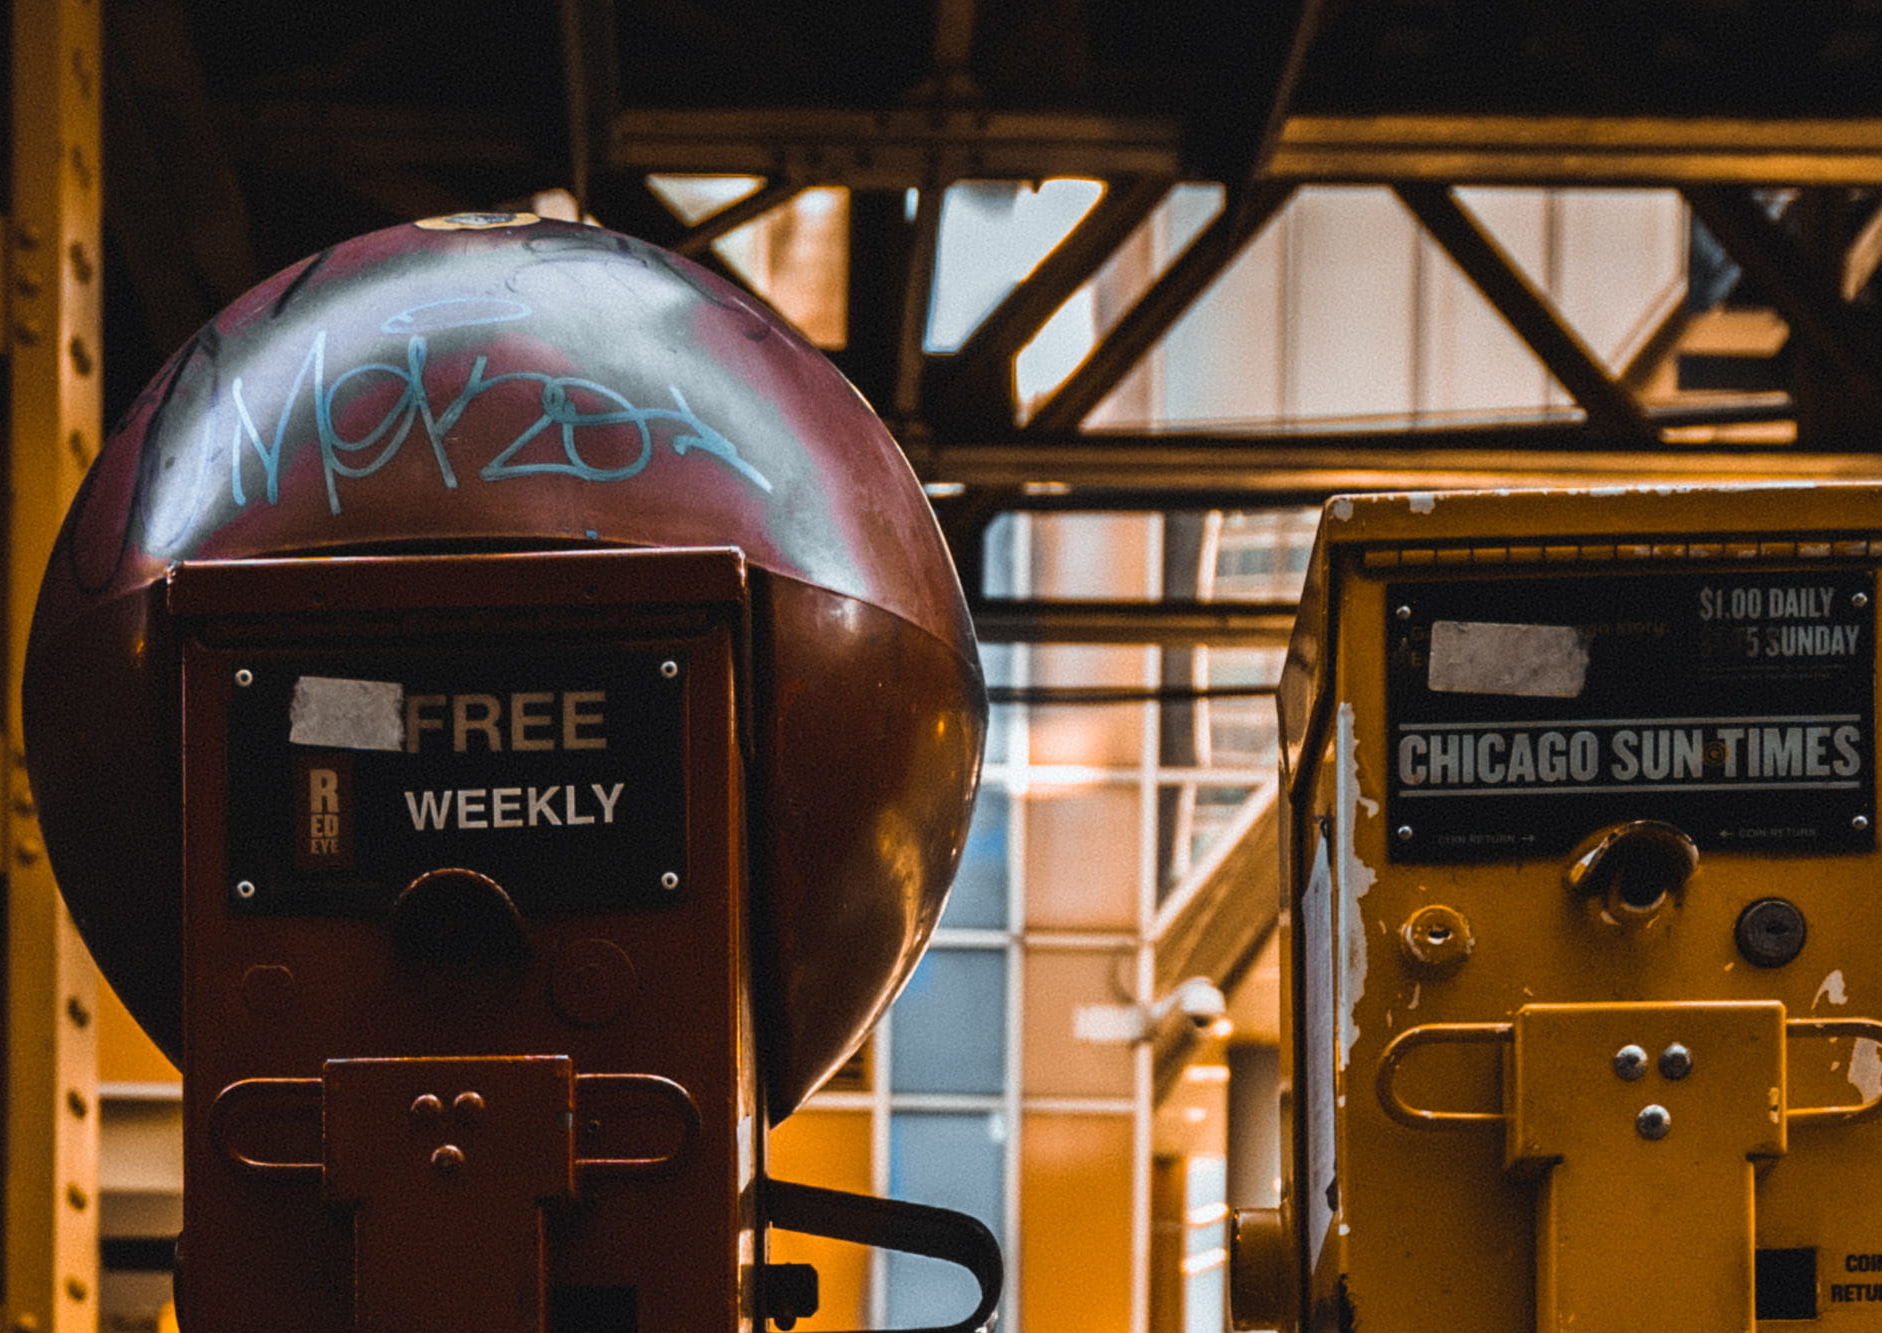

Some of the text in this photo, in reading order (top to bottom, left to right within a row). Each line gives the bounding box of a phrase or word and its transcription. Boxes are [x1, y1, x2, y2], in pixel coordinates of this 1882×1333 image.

[1699, 586, 1835, 621] $1.00 DAILY
[1765, 624, 1860, 658] SUNDAY
[407, 690, 608, 753] FREE
[1398, 729, 1599, 787] CHICAGO
[404, 783, 624, 831] WEEKLY
